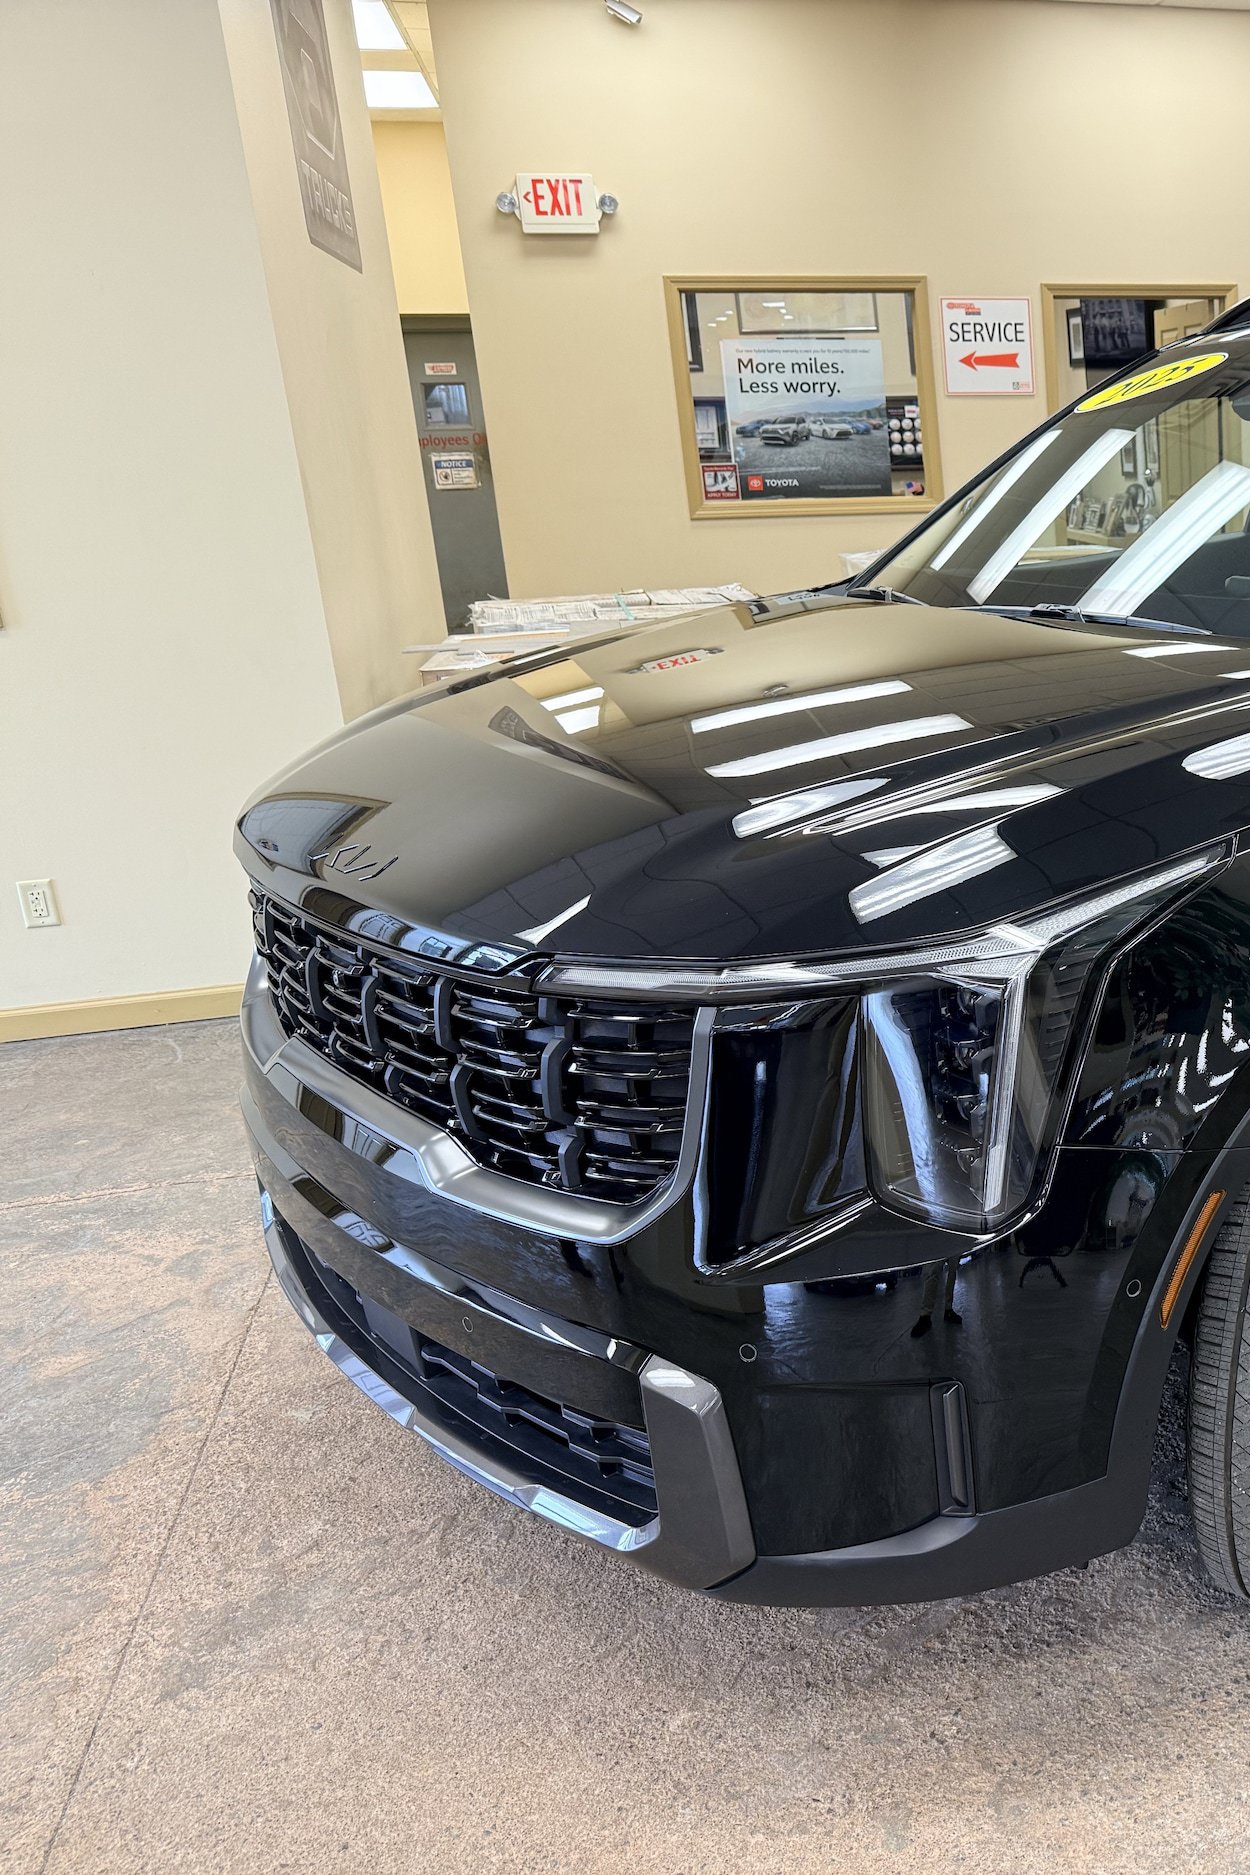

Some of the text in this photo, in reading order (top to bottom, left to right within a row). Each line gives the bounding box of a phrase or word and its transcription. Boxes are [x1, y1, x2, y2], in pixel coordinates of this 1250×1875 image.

[531, 179, 582, 216] EXIT
[949, 322, 1025, 342] SERVICE
[737, 357, 845, 374] More miles.
[739, 378, 841, 397] Less worry.
[1093, 358, 1208, 407] 2025
[419, 434, 469, 449] ployees
[441, 460, 466, 468] NOTICE
[765, 479, 799, 487] TOYOTA
